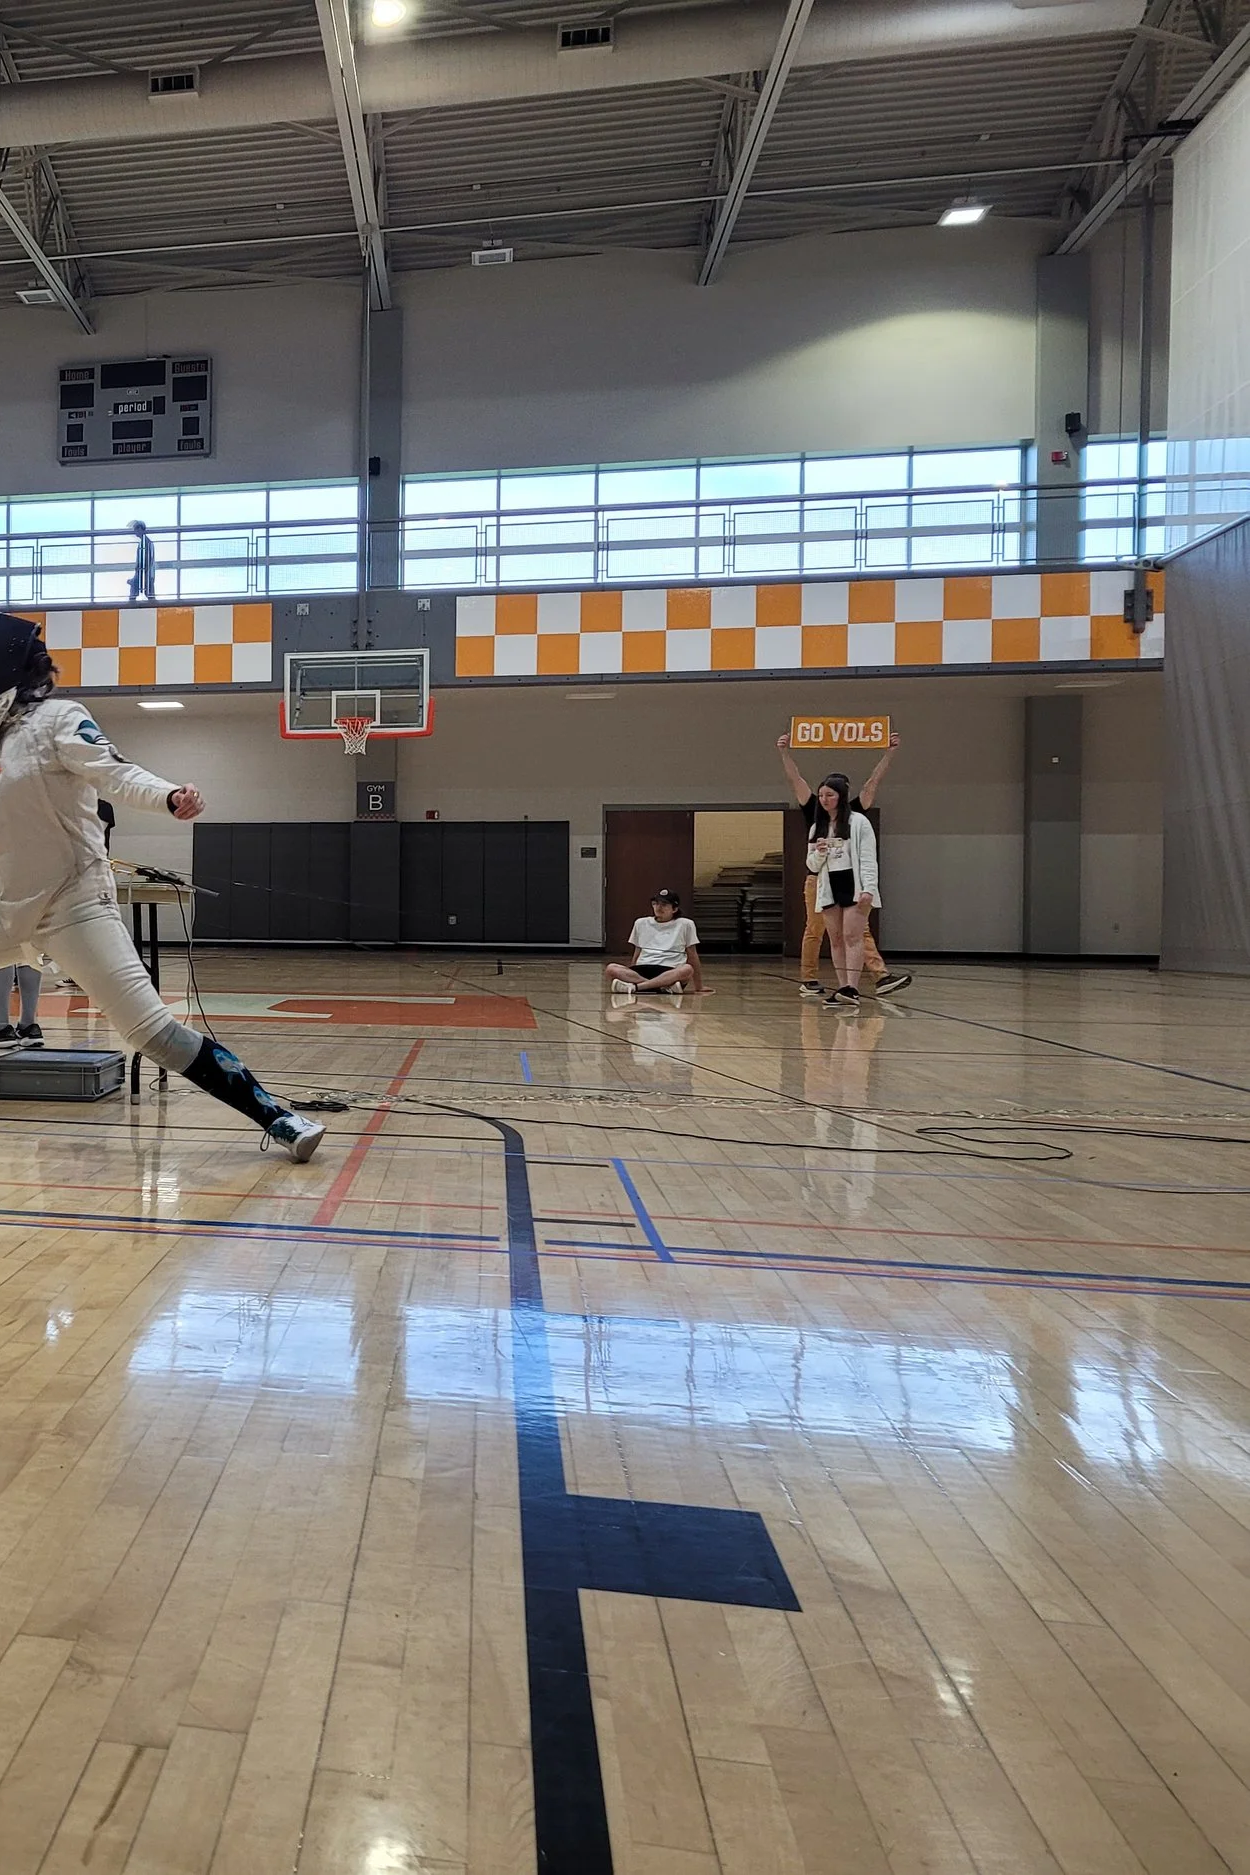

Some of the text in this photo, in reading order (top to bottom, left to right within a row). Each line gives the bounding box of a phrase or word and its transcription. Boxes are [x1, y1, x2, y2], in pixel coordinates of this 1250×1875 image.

[65, 370, 90, 380] Home
[118, 401, 147, 415] period
[117, 443, 147, 455] player
[797, 722, 883, 742] GO VOLS
[369, 794, 383, 811] B
